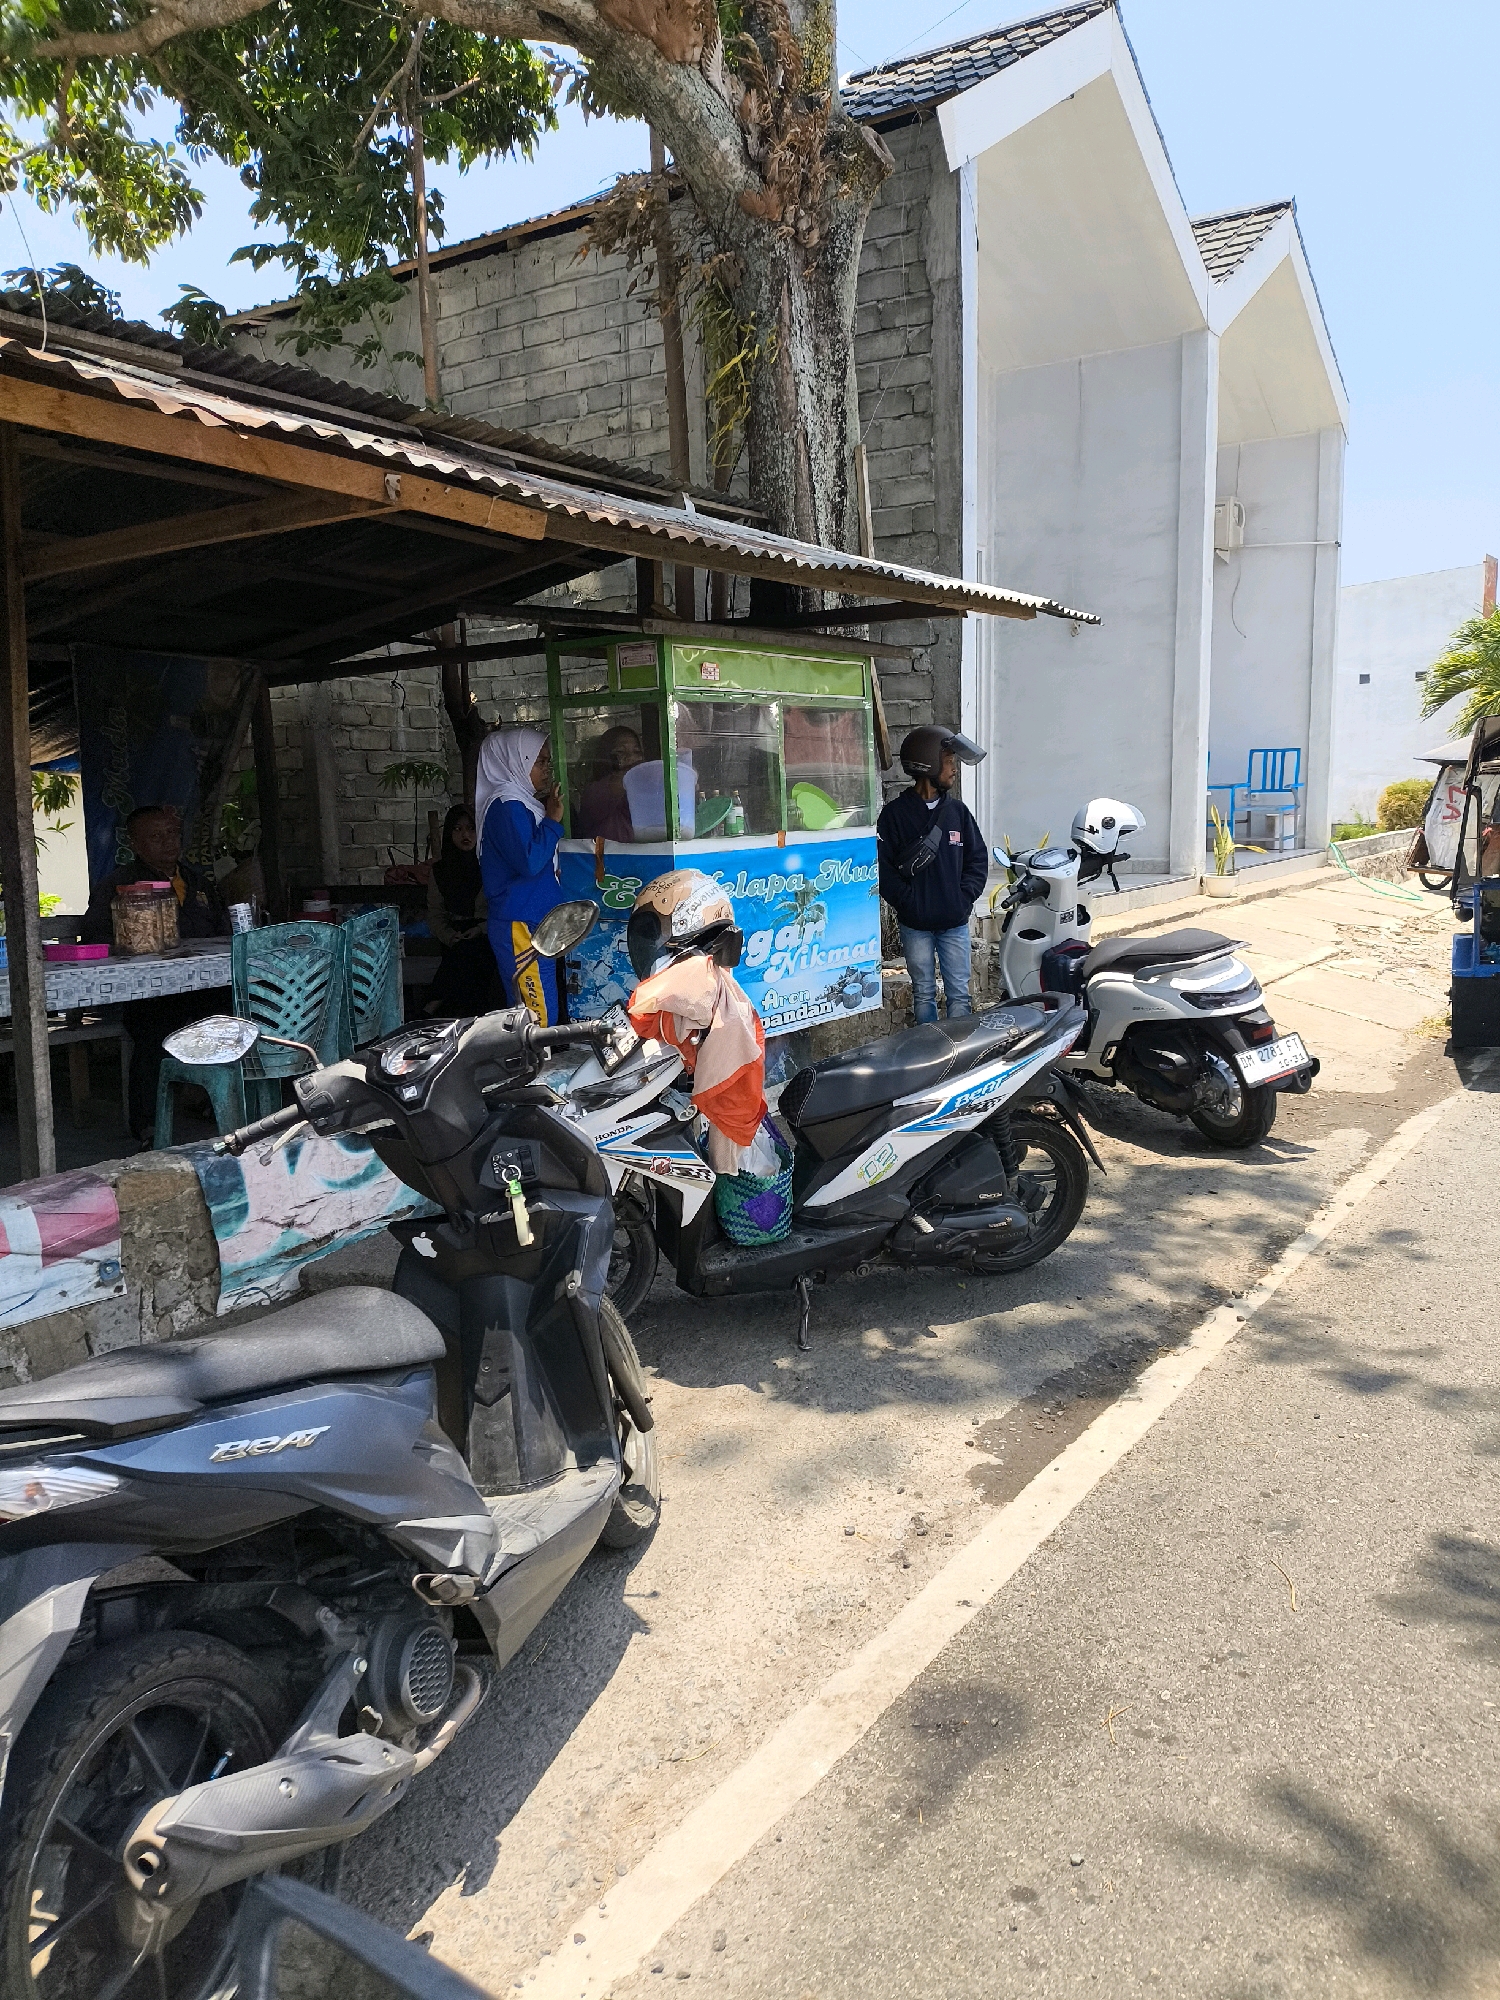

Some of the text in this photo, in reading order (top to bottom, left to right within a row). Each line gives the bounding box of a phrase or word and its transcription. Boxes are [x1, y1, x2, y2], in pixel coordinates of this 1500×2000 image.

[712, 870, 806, 903] elapa
[763, 937, 878, 984] Nikmat
[761, 1001, 834, 1030] pandan
[1257, 1044, 1283, 1063] 2781
[594, 1124, 634, 1142] HONDA
